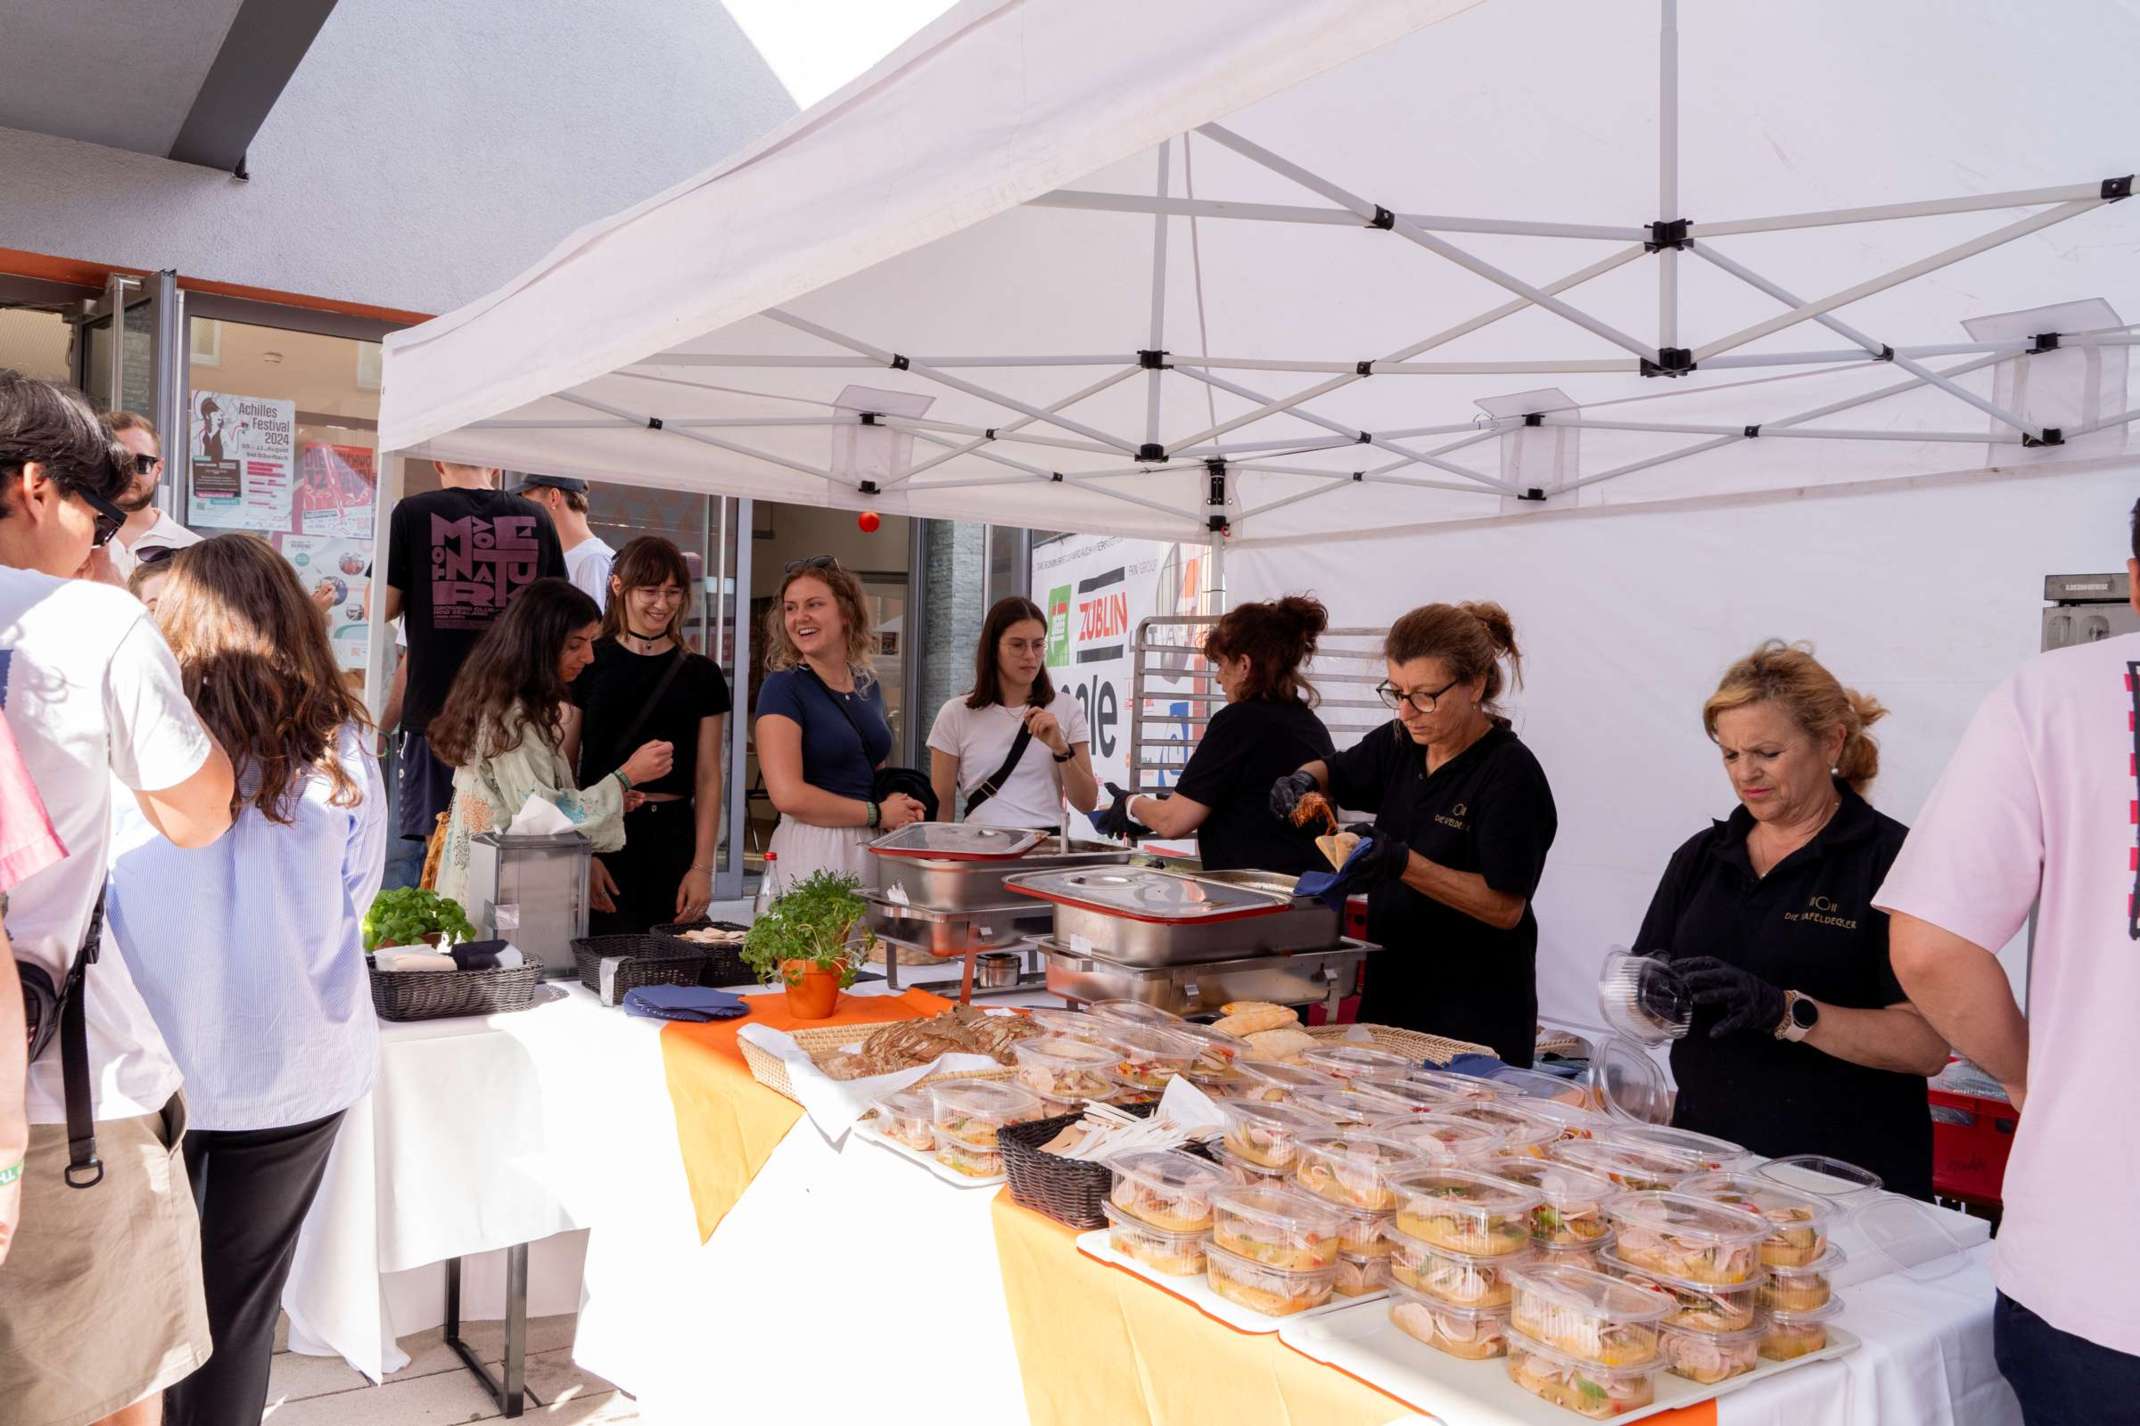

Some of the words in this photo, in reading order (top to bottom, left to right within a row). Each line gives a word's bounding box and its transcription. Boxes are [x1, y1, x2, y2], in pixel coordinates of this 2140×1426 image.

[239, 402, 278, 419] Achilles
[252, 417, 290, 433] Festival
[264, 432, 290, 446] 2024
